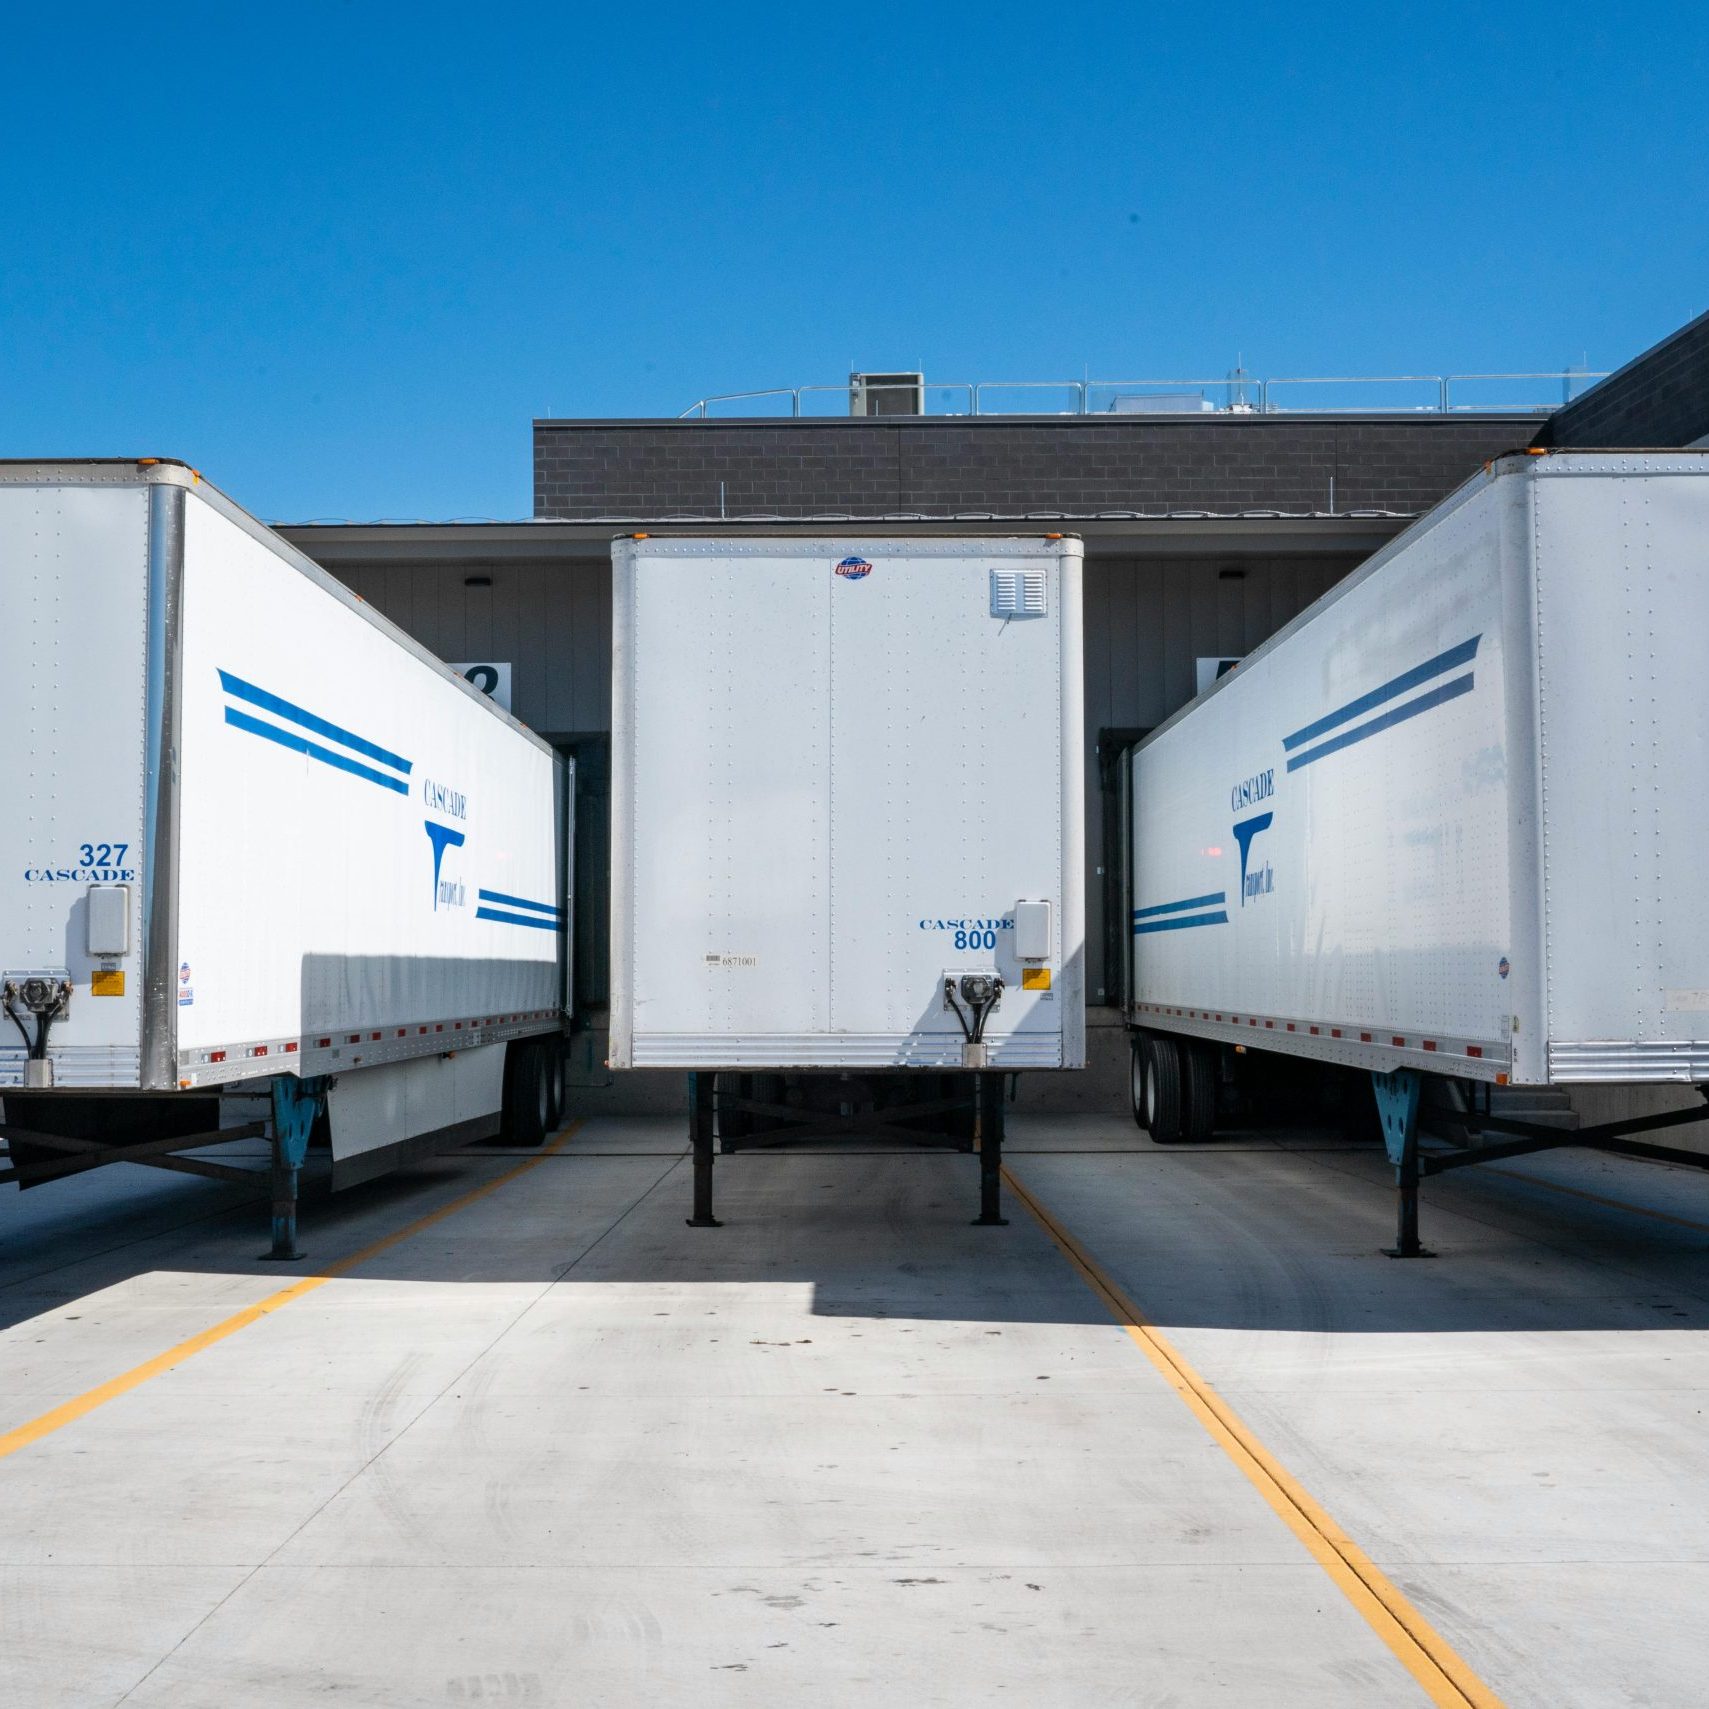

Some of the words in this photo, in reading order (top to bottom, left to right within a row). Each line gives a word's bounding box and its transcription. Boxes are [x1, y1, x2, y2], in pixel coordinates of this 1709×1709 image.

[836, 564, 871, 575] UTILITY
[1231, 768, 1274, 812] CASCADE
[424, 778, 467, 820] CASCADE
[79, 844, 129, 867] 327
[24, 869, 135, 882] CASCADE
[919, 919, 1015, 930] CASCADE
[954, 930, 997, 950] 800
[722, 957, 756, 967] 6871001
